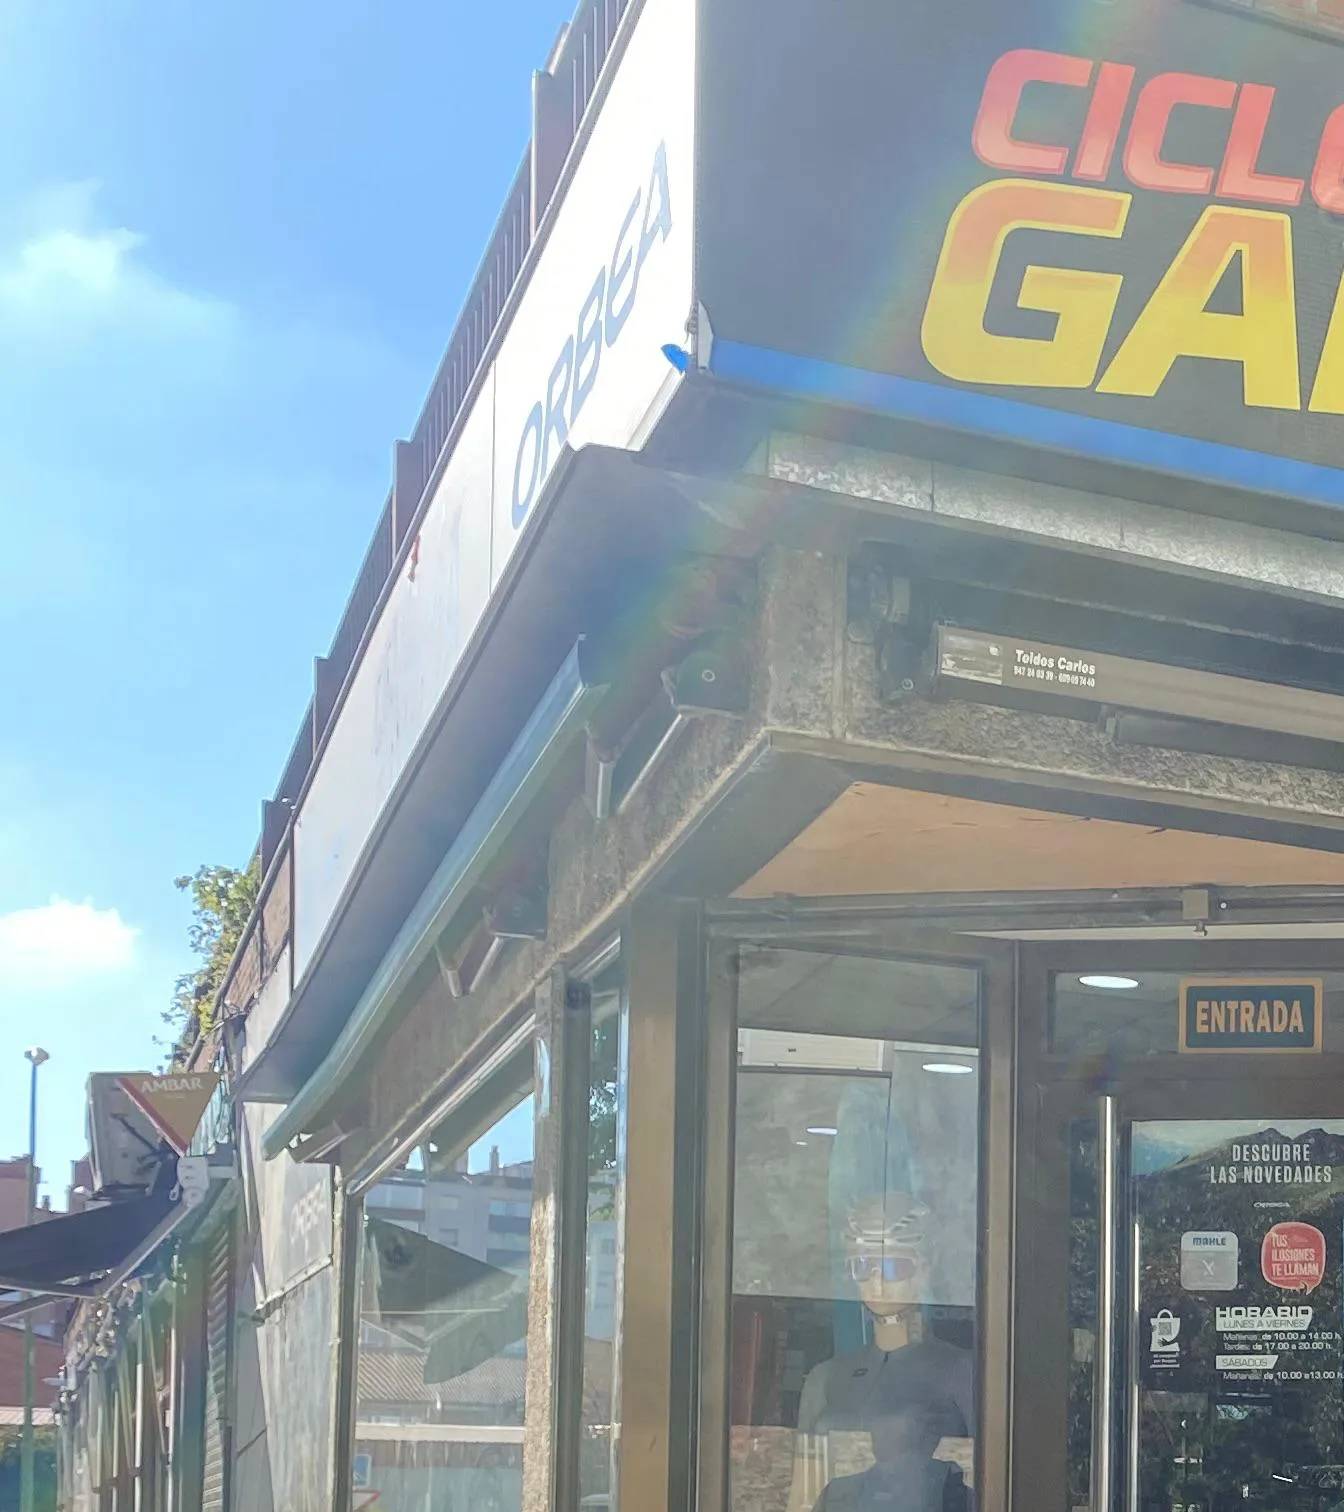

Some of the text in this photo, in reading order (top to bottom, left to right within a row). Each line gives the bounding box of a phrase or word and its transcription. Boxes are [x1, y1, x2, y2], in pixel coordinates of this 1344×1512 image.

[511, 138, 672, 530] ORBEA
[1015, 649, 1096, 675] Toldos Carlos
[1196, 1000, 1305, 1034] ENTRADA
[141, 1078, 204, 1094] AMBAR
[1232, 1144, 1310, 1162] DESCUBRE
[1210, 1165, 1332, 1184] LAS NOVEDADES
[1192, 1237, 1227, 1247] MAHLE
[1271, 1263, 1319, 1276] TE LLAMAN
[1223, 1319, 1306, 1329] LUNES A VIERNES
